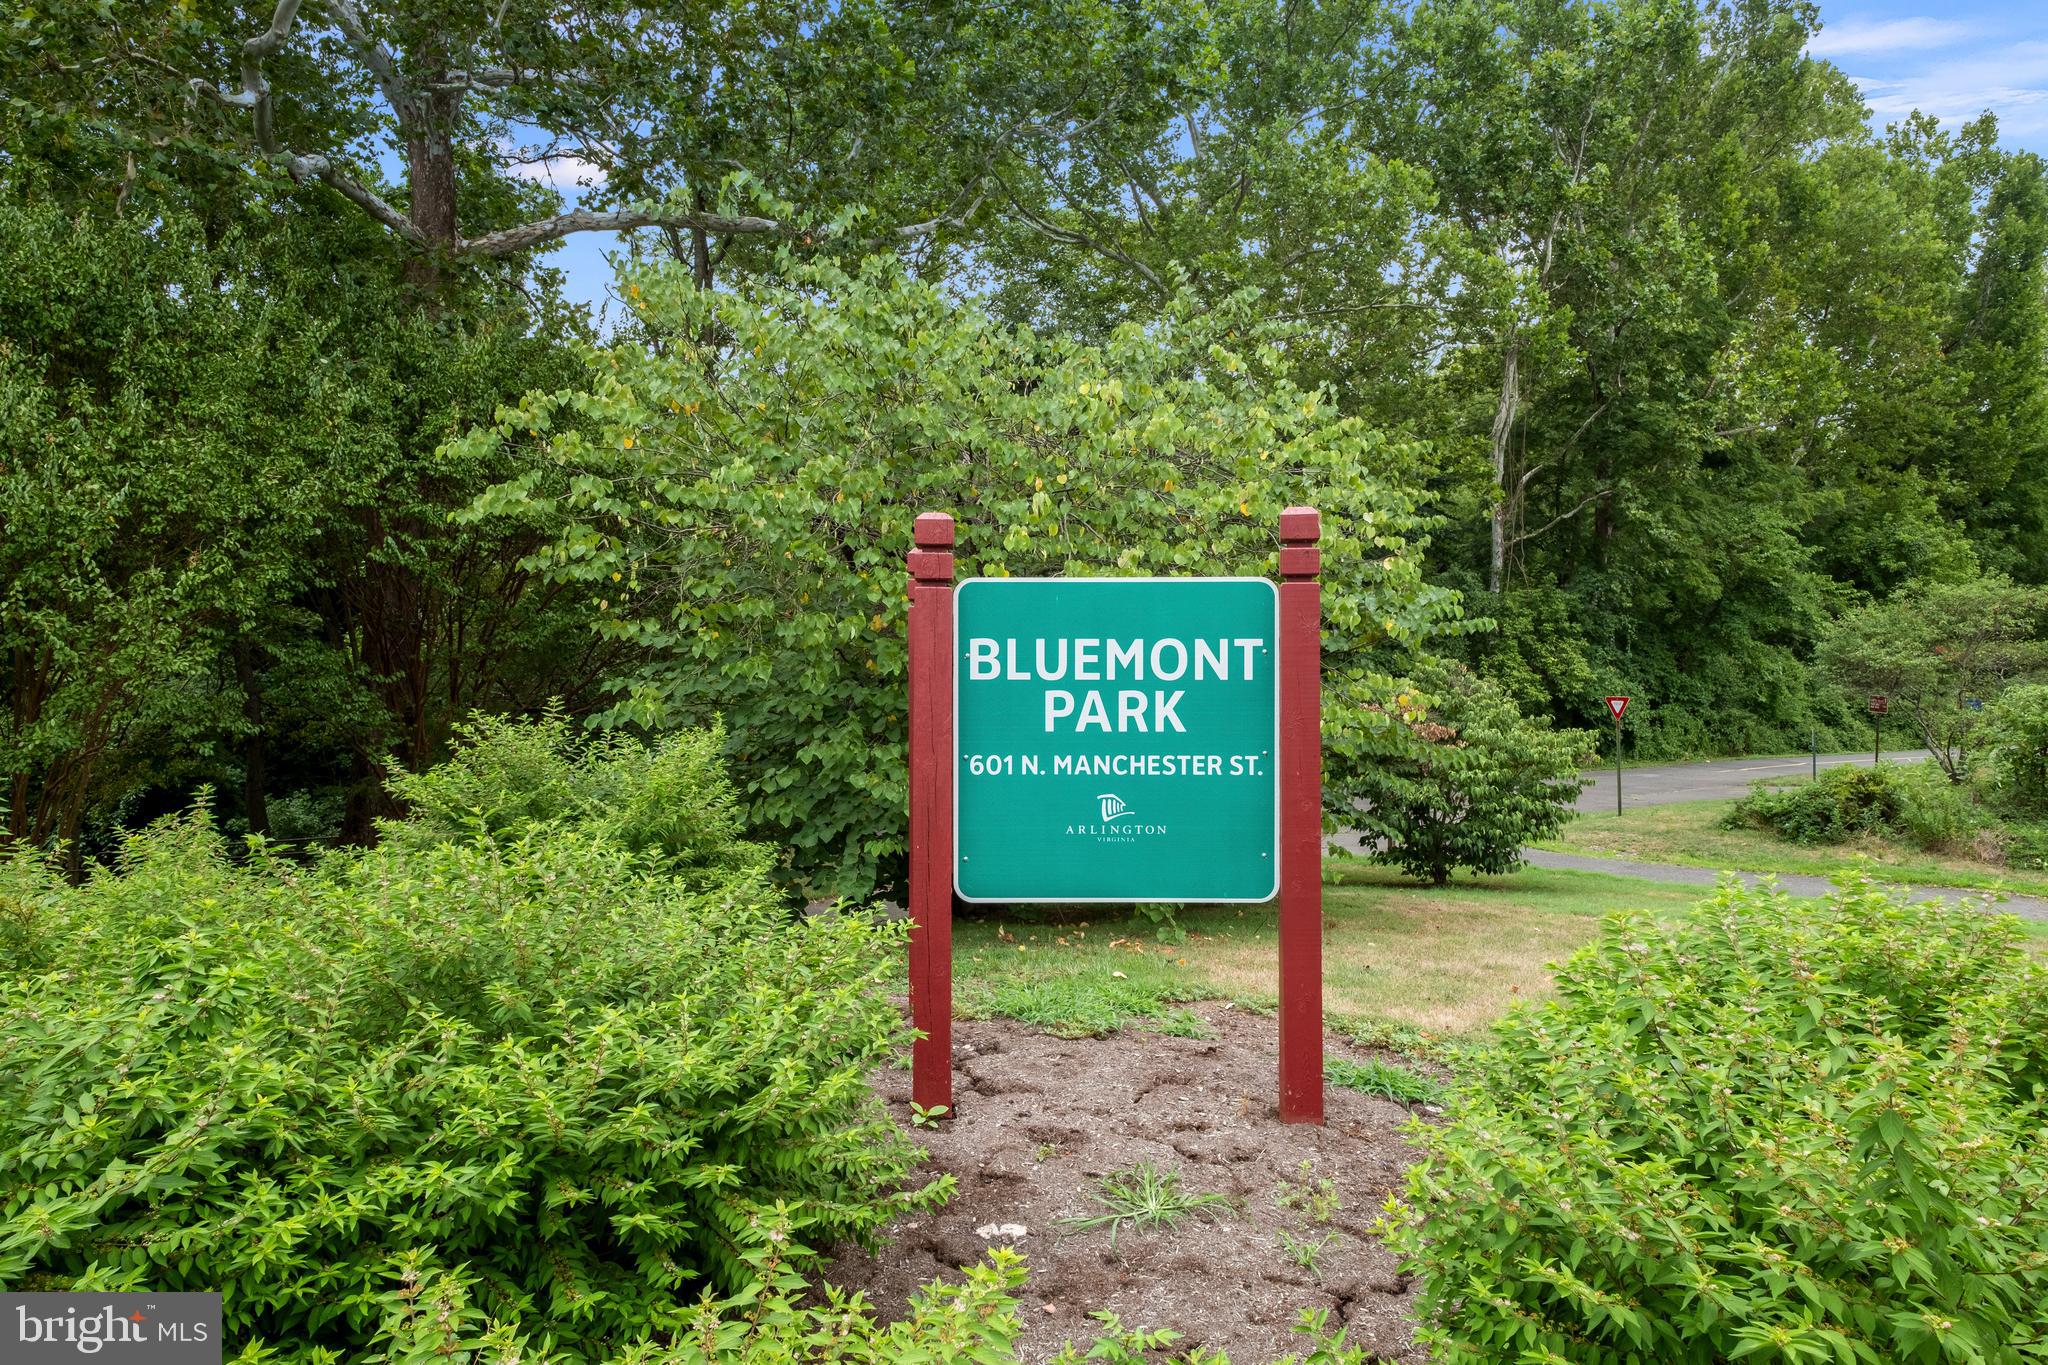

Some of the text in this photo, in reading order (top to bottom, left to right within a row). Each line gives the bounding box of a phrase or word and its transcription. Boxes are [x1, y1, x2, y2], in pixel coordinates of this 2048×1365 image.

[968, 637, 1264, 681] BLUEMONT
[1044, 689, 1187, 733] PARK
[969, 754, 1263, 776] 601 N. MANCHESTER ST.
[1066, 825, 1167, 835] ARLINGTON
